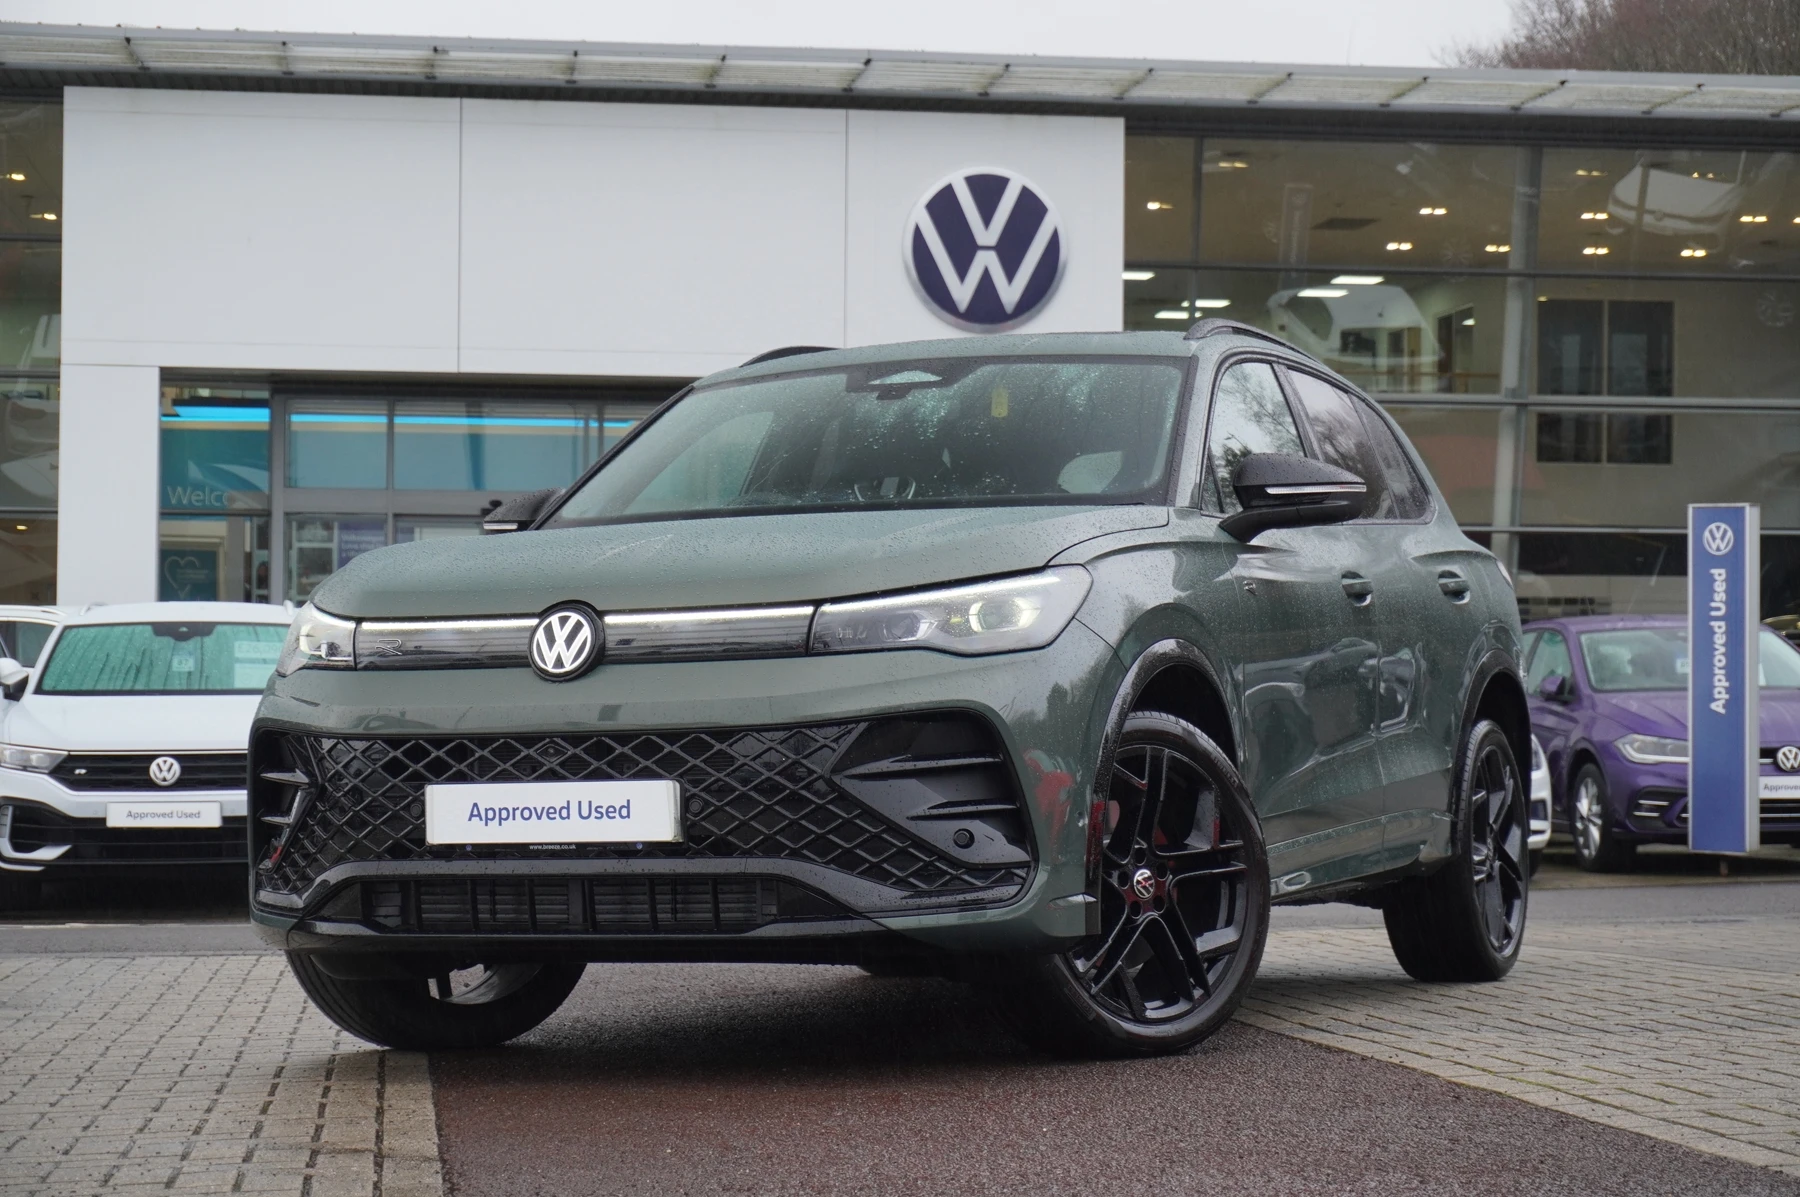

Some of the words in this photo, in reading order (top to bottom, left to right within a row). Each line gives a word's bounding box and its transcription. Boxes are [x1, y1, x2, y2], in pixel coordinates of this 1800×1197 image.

[1709, 568, 1727, 616] Used
[1709, 620, 1729, 714] Approved
[1763, 782, 1800, 792] Approve
[126, 810, 174, 820] Approved
[176, 810, 201, 819] Used
[467, 800, 571, 827] Approved
[577, 799, 631, 820] Used
[528, 843, 577, 851] www.breeze.co.uk
